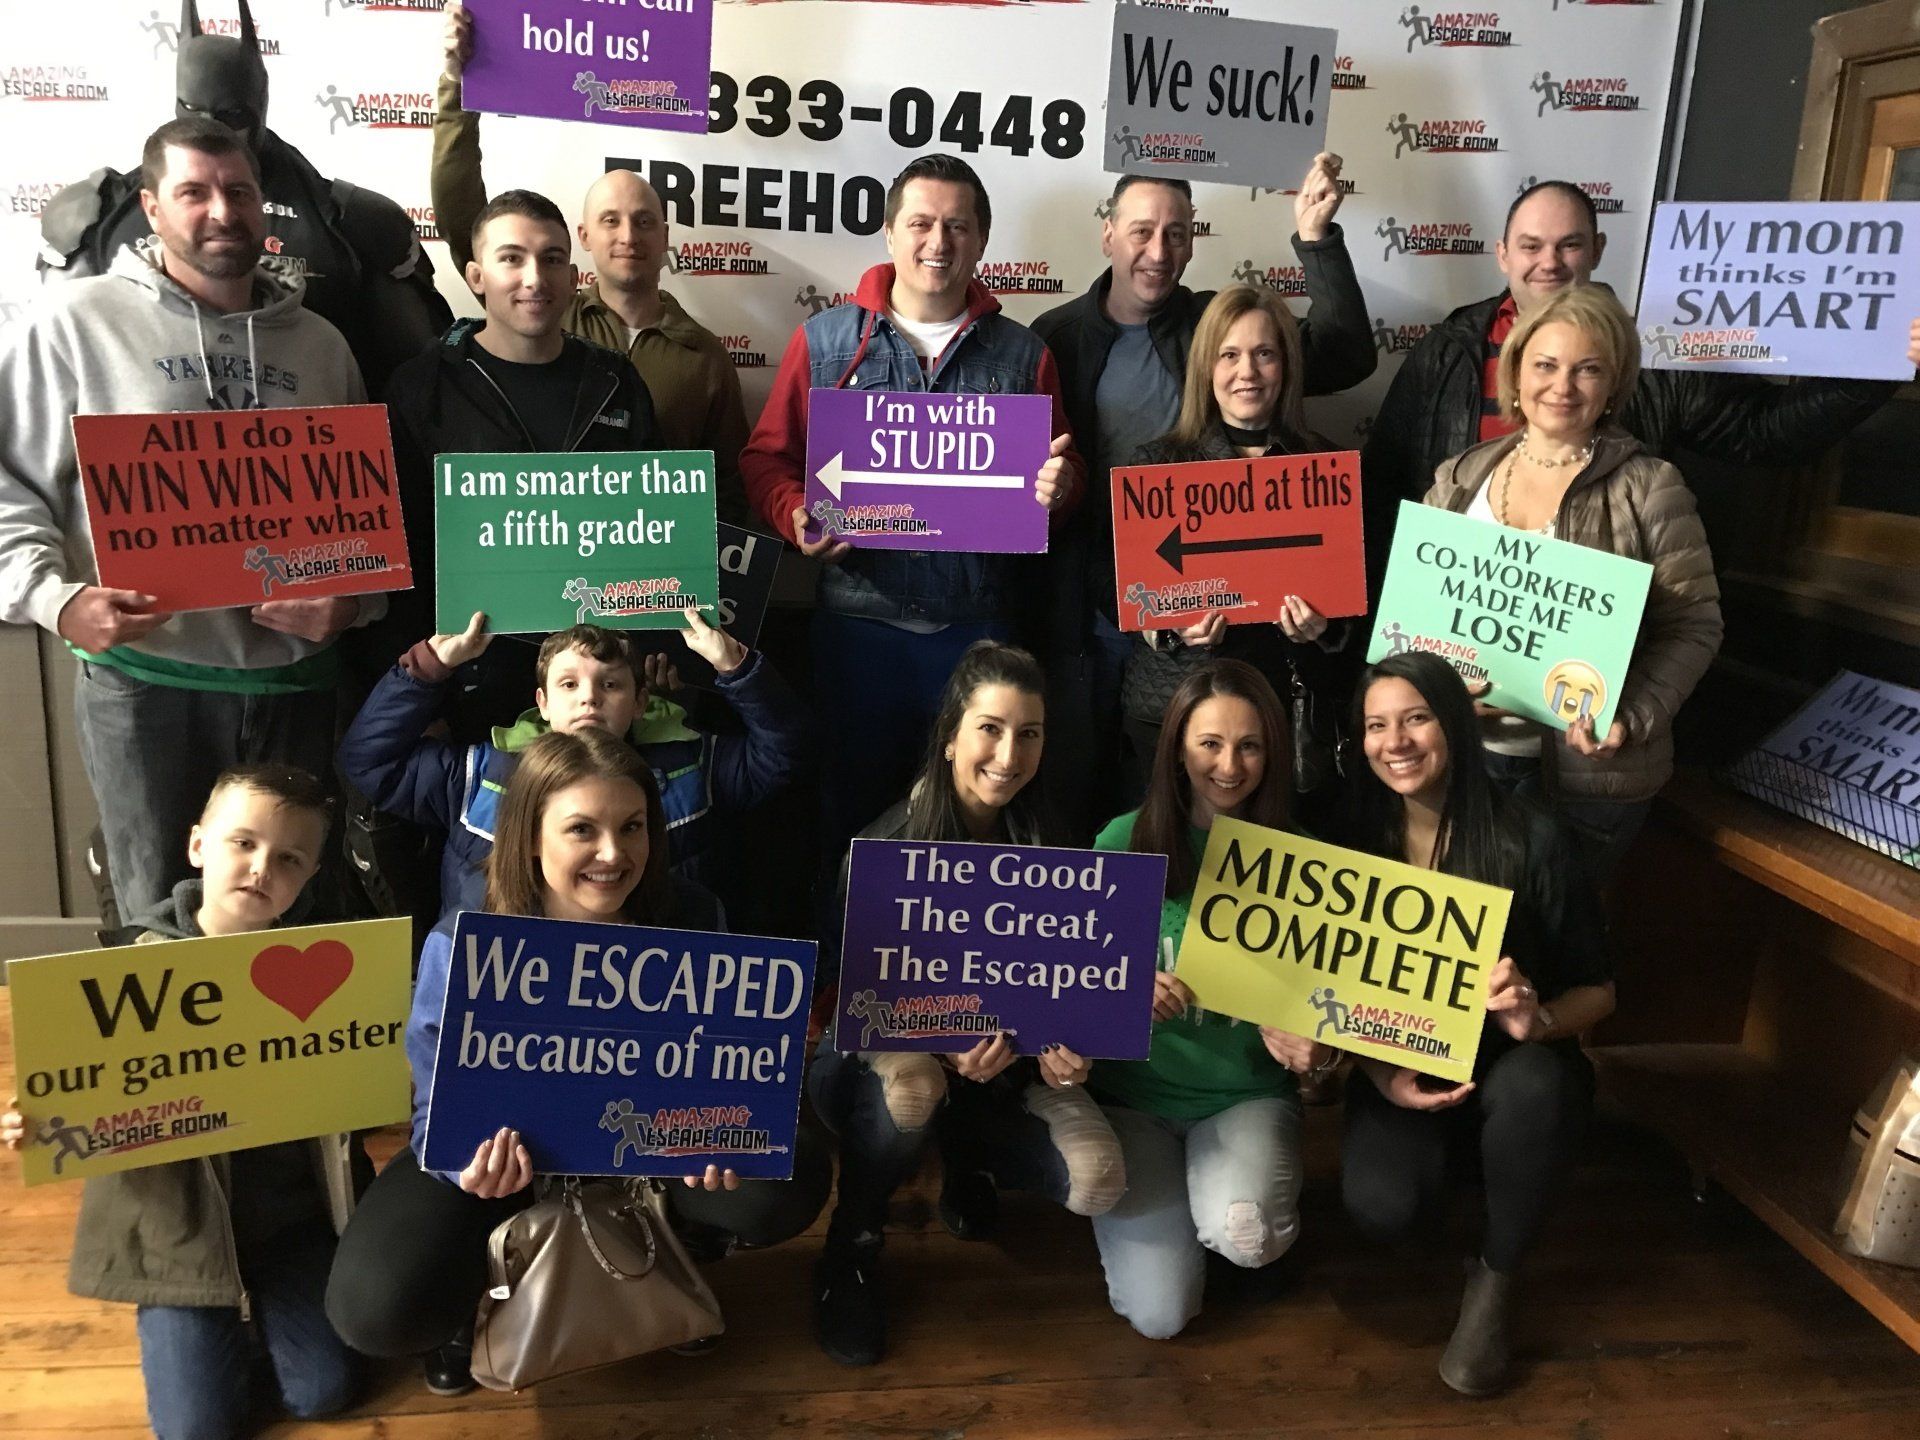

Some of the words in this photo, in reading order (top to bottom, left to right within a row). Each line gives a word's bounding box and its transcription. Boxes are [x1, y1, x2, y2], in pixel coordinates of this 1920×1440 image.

[1434, 12, 1501, 29] AMAZING
[523, 13, 594, 56] hold
[606, 30, 650, 62] us!
[1429, 26, 1475, 43] ESCAPE
[1477, 28, 1512, 46] ROOM
[10, 66, 87, 81] AMAZING
[1123, 33, 1193, 112] We
[1206, 46, 1321, 126] suck!
[1564, 78, 1629, 93] AMAZING
[4, 80, 61, 97] ESCAPE
[67, 84, 108, 100] ROOM
[610, 80, 677, 96] AMAZING
[1559, 90, 1605, 107] ESCAPE
[1607, 93, 1640, 110] ROOM
[356, 93, 434, 108] AMAZING
[606, 92, 651, 108] ESCAPE
[655, 96, 690, 112] ROOM
[352, 107, 406, 123] ESCAPE
[1421, 119, 1487, 134] AMAZING
[1144, 133, 1204, 148] AMAZING
[1416, 132, 1461, 149] ESCAPE
[1464, 135, 1499, 151] ROOM
[1140, 145, 1181, 160] ESCAPE
[1184, 149, 1216, 163] ROOM
[605, 157, 895, 237] REEHO
[1409, 223, 1473, 239] AMAZING
[1670, 208, 1736, 265] My
[1746, 218, 1905, 255] mom
[681, 242, 753, 257] AMAZING
[1405, 236, 1448, 251] ESCAPE
[1451, 238, 1485, 254] ROOM
[677, 255, 726, 271] ESCAPE
[730, 258, 768, 274] ROOM
[982, 262, 1049, 276] AMAZING
[1267, 266, 1305, 281] AMAZ
[1678, 263, 1807, 285] thinks
[1825, 265, 1897, 286] I'm
[1028, 278, 1063, 293] ROOM
[1672, 288, 1896, 331] SMART
[1680, 328, 1757, 344] AMAZING
[1674, 343, 1725, 358] ESCAPE
[1730, 344, 1771, 358] ROOM
[153, 352, 299, 395] YANKEES
[865, 395, 915, 424] I'm
[926, 395, 996, 426] with
[142, 419, 198, 453] All
[214, 421, 227, 450] I
[242, 417, 293, 448] do
[307, 415, 336, 445] is
[870, 428, 995, 471] STUPID
[87, 460, 190, 515] WIN
[197, 454, 294, 509] WIN
[301, 449, 390, 502] WIN
[443, 463, 452, 496] I
[460, 470, 507, 497] am
[515, 464, 633, 497] smarter
[641, 458, 707, 494] than
[1122, 474, 1177, 521] Not
[1184, 463, 1255, 533] good
[1264, 467, 1293, 512] at
[1300, 458, 1352, 509] this
[846, 504, 914, 519] AMAZING
[109, 525, 158, 552] no
[172, 514, 293, 547] matter
[305, 503, 391, 536] what
[478, 521, 496, 547] a
[503, 509, 569, 546] fifth
[578, 509, 676, 557] grader
[842, 517, 888, 532] ESCAPE
[893, 519, 927, 532] ROOM
[286, 538, 368, 562] AMAZING
[1494, 534, 1542, 565] MY
[285, 557, 342, 578] ESCAPE
[346, 554, 387, 573] ROOM
[603, 577, 682, 599] AMAZING
[1160, 578, 1229, 599] AMAZING
[1416, 541, 1616, 617] CO-WORKERS
[600, 595, 652, 611] ESCAPE
[656, 594, 698, 609] ROOM
[1157, 595, 1203, 611] ESCAPE
[1207, 593, 1242, 608] ROOM
[1440, 575, 1525, 620] MADE
[1528, 601, 1573, 634] ME
[1450, 608, 1547, 661] LOSE
[1411, 635, 1478, 661] AMAZING
[1453, 659, 1489, 681] ROOM
[1831, 679, 1891, 726] My
[1816, 718, 1906, 758] thinks
[900, 847, 975, 884] The
[989, 853, 1117, 900] Good,
[1216, 838, 1489, 953] MISSION
[895, 896, 970, 934] The
[984, 902, 1114, 949] Great,
[1200, 893, 1480, 1013] COMPLETE
[465, 933, 550, 1006] We
[567, 942, 804, 1021] ESCAPED
[873, 945, 949, 983] The
[961, 950, 1129, 999] Escaped
[80, 968, 224, 1039] We
[893, 994, 983, 1015] AMAZING
[887, 1013, 949, 1031] ESCAPE
[953, 1014, 999, 1032] ROOM
[1350, 1003, 1437, 1035] AMAZING
[458, 1011, 641, 1076] because
[655, 1025, 704, 1078] of
[711, 1033, 791, 1083] me!
[1344, 1015, 1403, 1045] ESCAPE
[1405, 1033, 1452, 1059] ROOM
[26, 1062, 107, 1098] our
[122, 1042, 247, 1096] game
[259, 1019, 402, 1063] master
[93, 1096, 205, 1135] AMAZING
[652, 1105, 753, 1129] AMAZING
[87, 1122, 164, 1151] ESCAPE
[171, 1111, 228, 1137] ROOM
[646, 1128, 713, 1148] ESCAPE
[718, 1130, 769, 1149] ROOM
